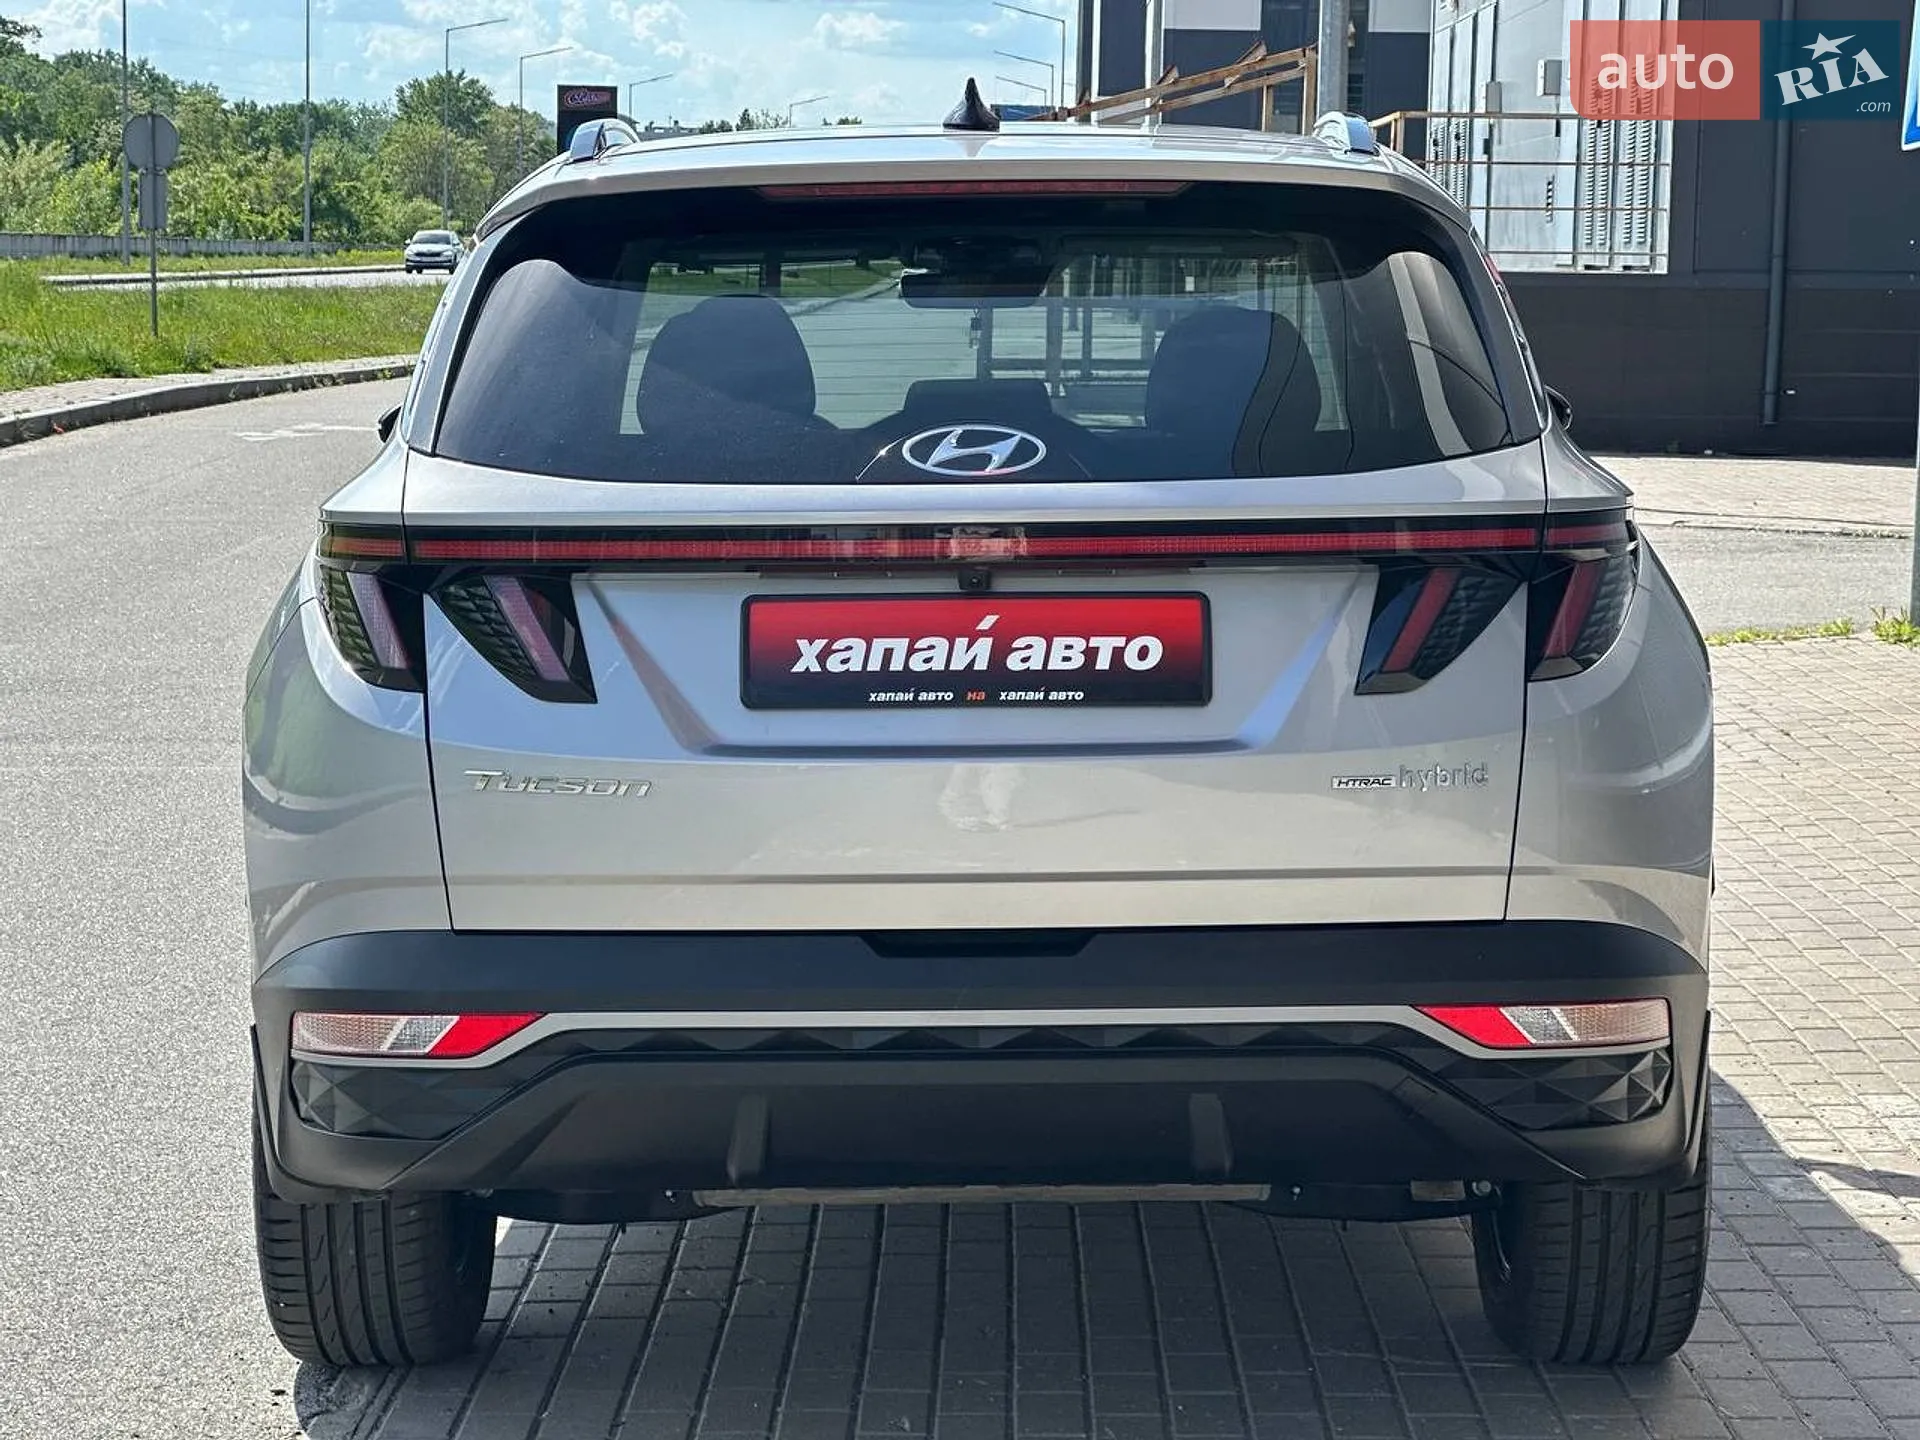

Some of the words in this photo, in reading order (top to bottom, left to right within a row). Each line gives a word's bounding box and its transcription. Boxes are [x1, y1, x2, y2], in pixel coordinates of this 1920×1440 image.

[790, 615, 1000, 673] хапай
[1006, 635, 1164, 671] авто
[917, 690, 954, 701] авто
[966, 689, 986, 701] на
[1048, 690, 1084, 701] авто
[1336, 778, 1394, 788] HTRAC
[1399, 763, 1489, 792] hybrid
